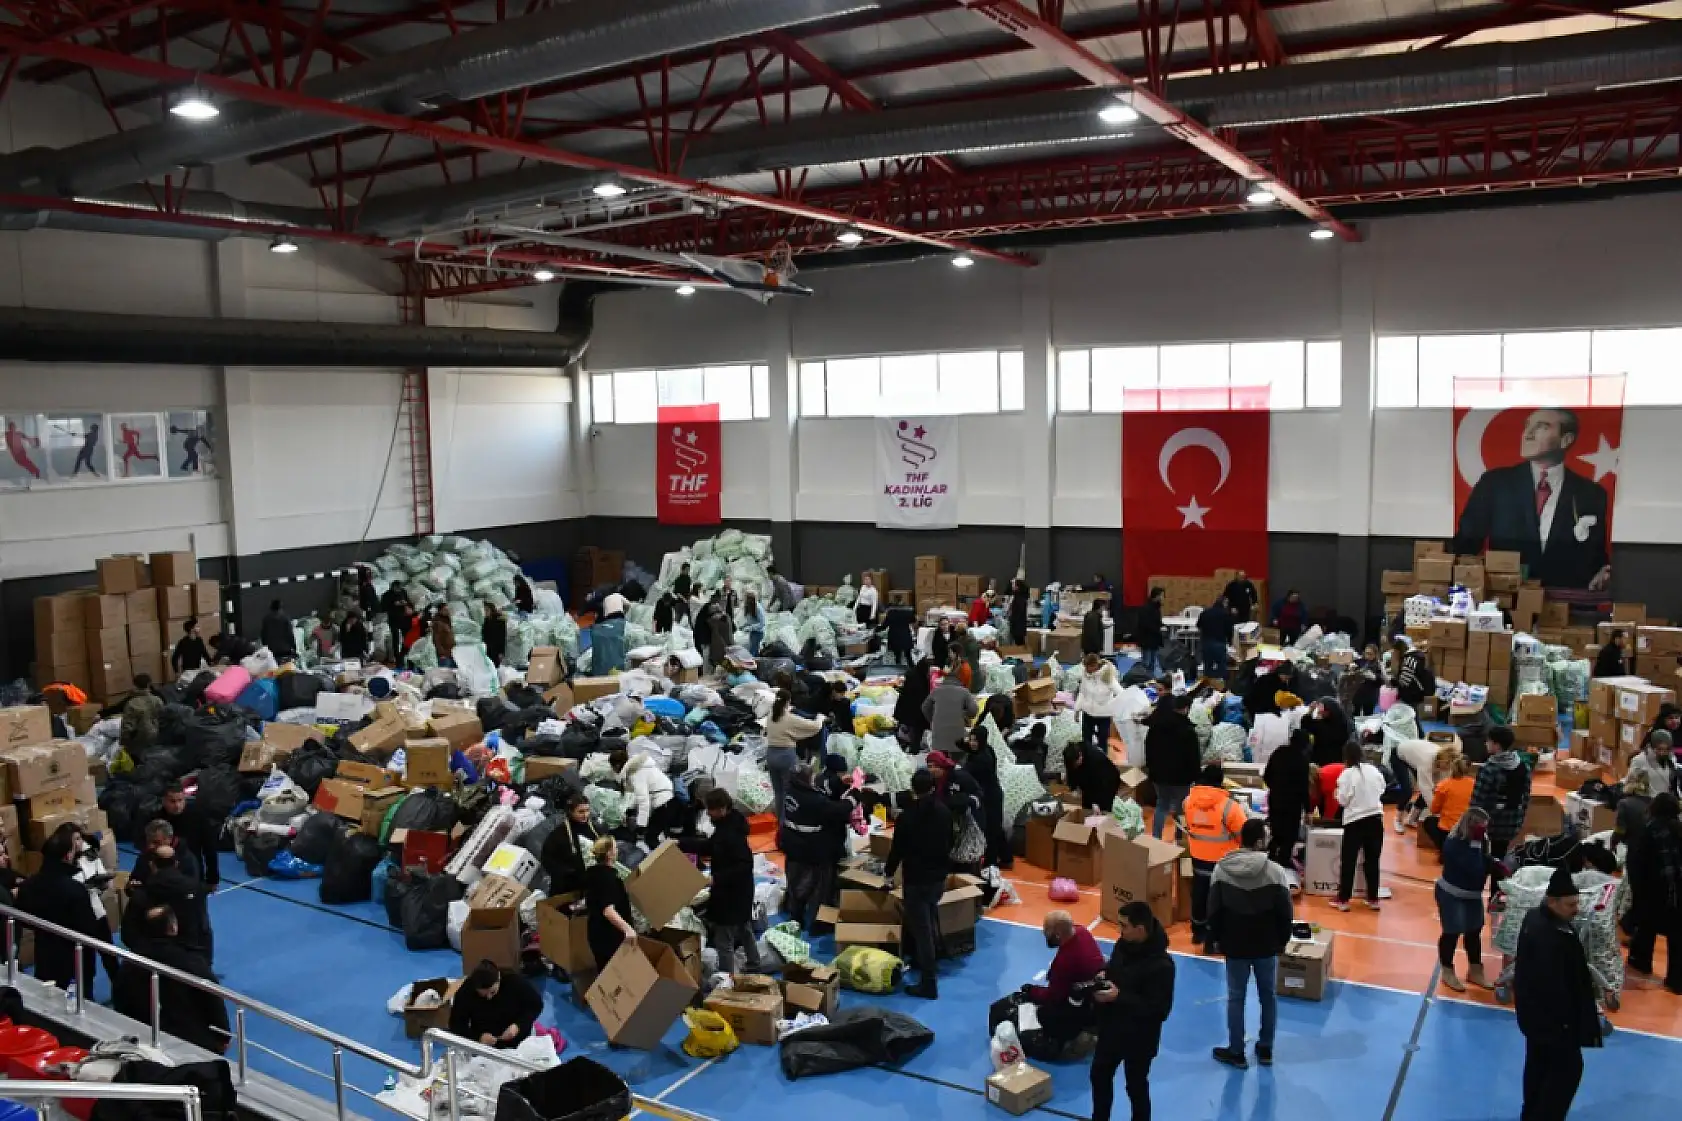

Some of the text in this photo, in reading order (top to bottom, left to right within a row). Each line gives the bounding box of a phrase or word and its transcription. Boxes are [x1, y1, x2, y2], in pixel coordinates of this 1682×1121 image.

[669, 473, 709, 491] THF
[905, 472, 929, 482] THF
[884, 484, 948, 494] KADINLAR
[899, 497, 910, 508] 2.
